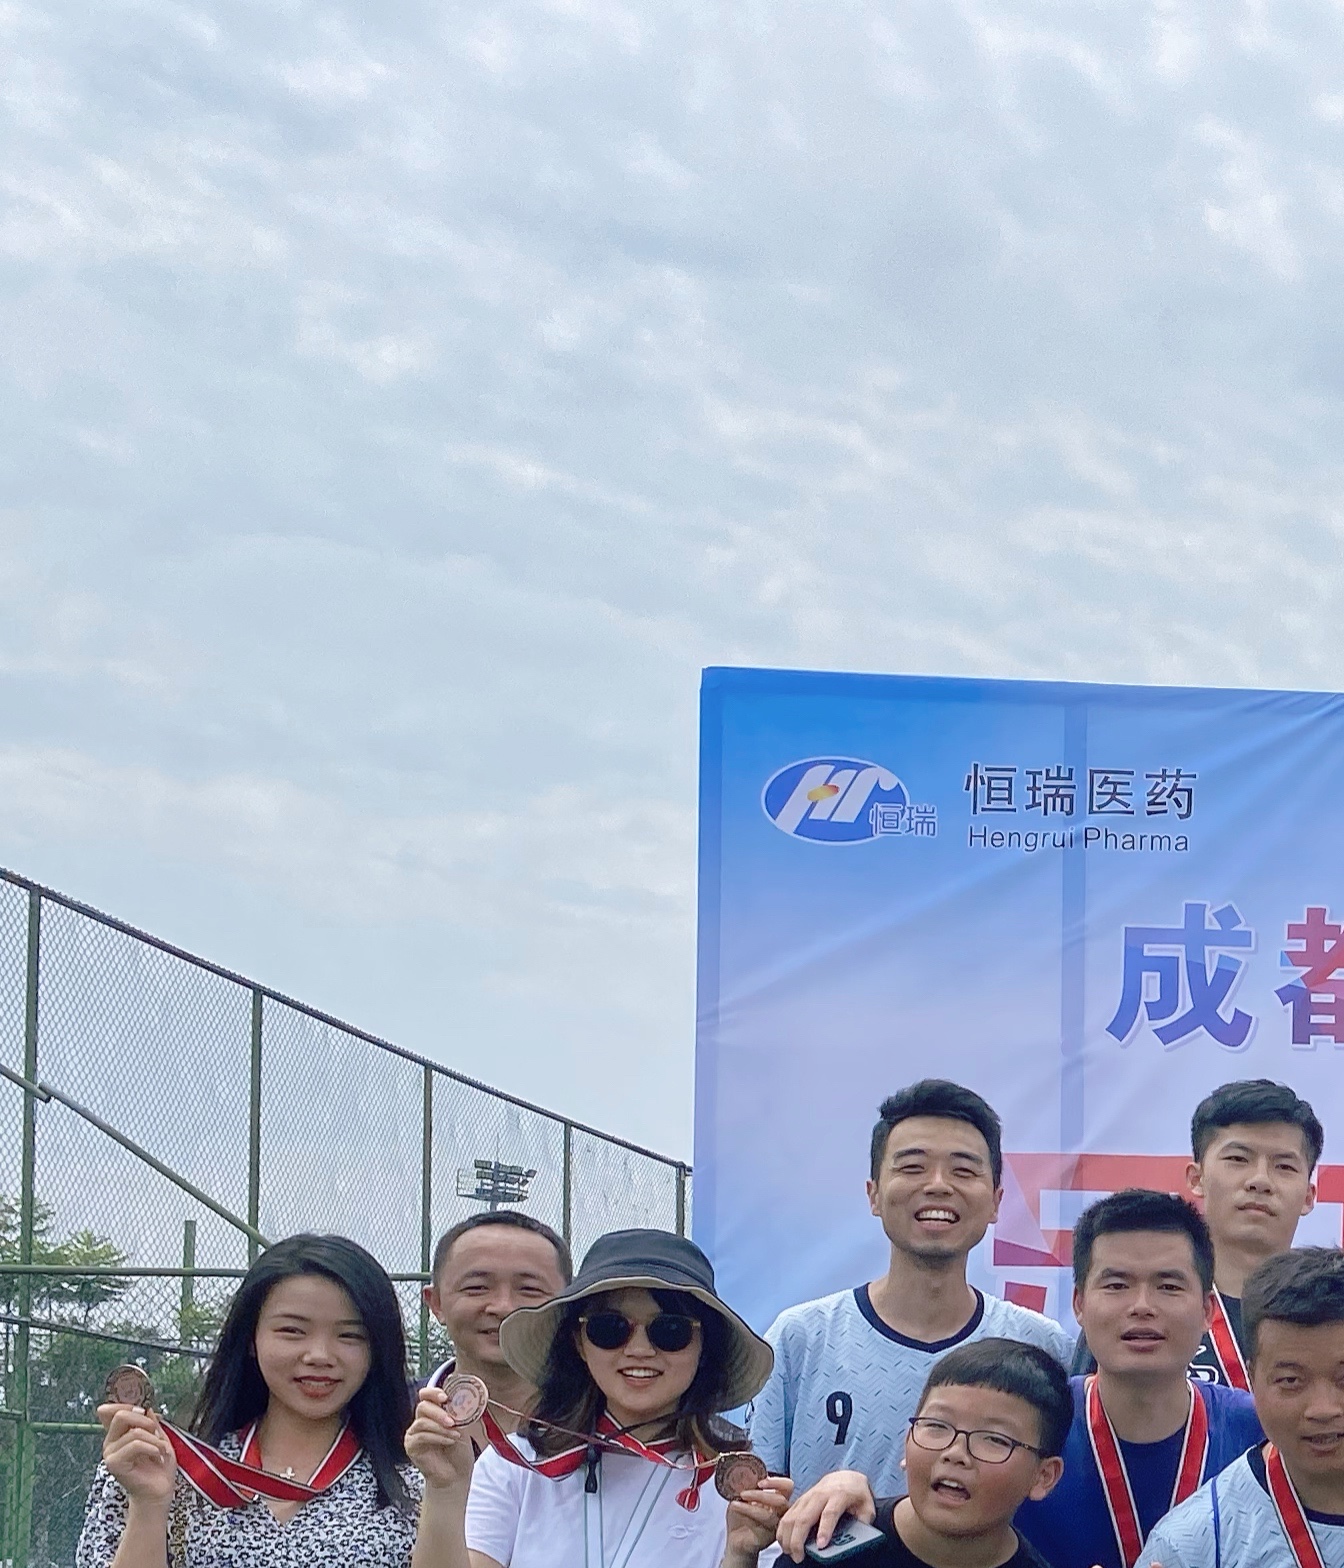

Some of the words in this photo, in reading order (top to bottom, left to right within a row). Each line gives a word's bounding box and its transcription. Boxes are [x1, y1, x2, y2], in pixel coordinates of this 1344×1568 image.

[963, 762, 1197, 820] 恒瑞医药
[869, 802, 937, 838] 恒瑞
[968, 826, 1075, 852] Hengrui
[1084, 827, 1189, 852] Pharma
[826, 1391, 852, 1445] 9
